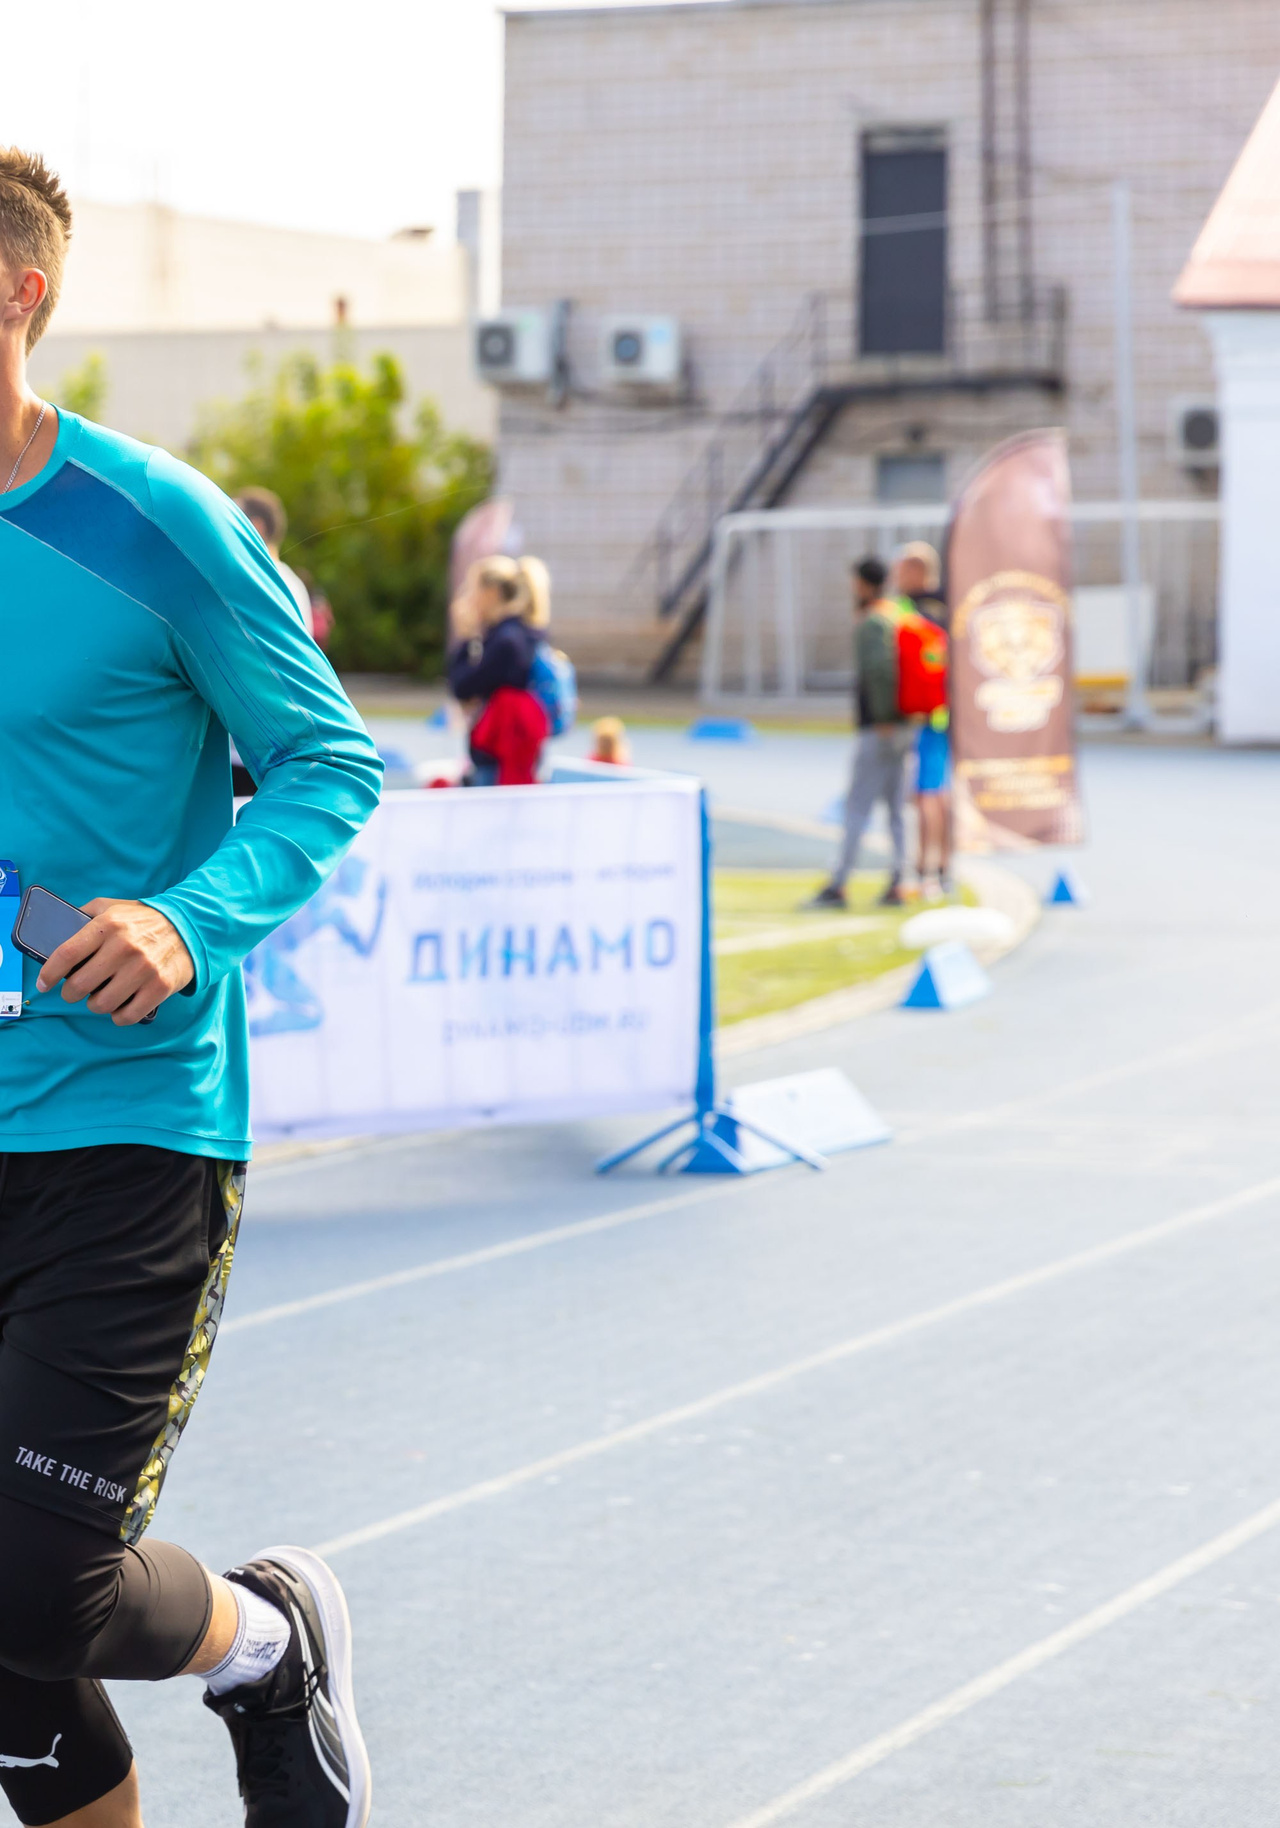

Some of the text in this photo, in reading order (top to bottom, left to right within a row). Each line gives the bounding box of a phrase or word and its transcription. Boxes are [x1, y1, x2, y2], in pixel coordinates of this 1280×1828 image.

[406, 917, 676, 985] ДИНАМО
[15, 1446, 127, 1504] TAKE THE RISK
